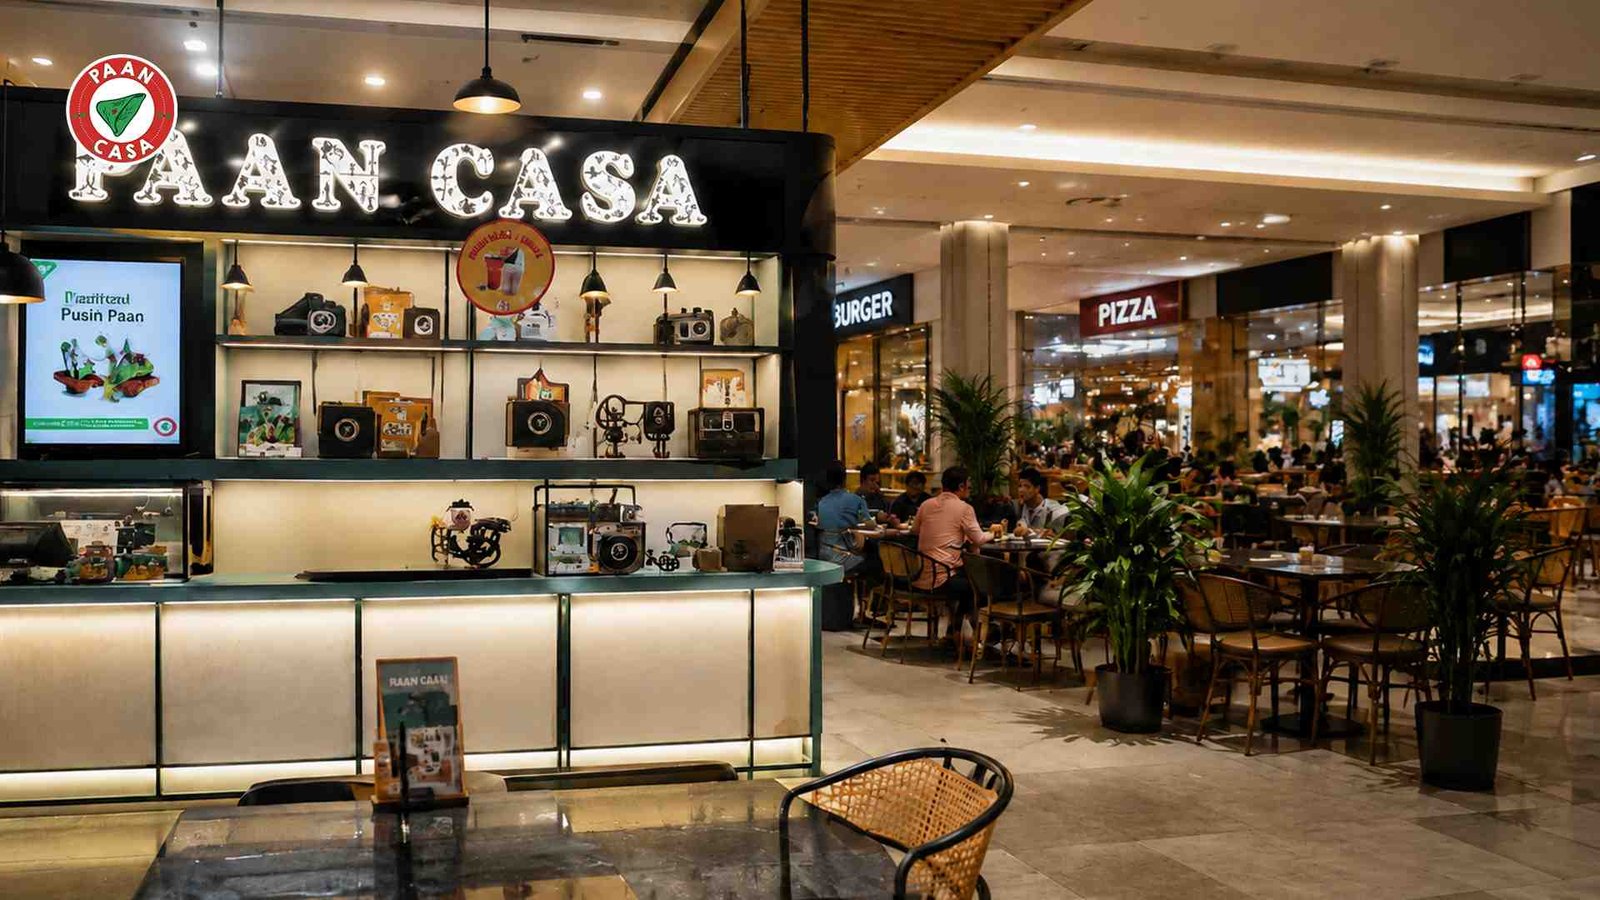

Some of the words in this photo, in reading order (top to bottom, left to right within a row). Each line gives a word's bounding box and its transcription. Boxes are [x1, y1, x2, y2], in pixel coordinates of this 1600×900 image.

[430, 144, 708, 226] CASA
[108, 309, 144, 322] Paan
[834, 290, 893, 328] BURGER
[1098, 295, 1157, 327] PIZZA
